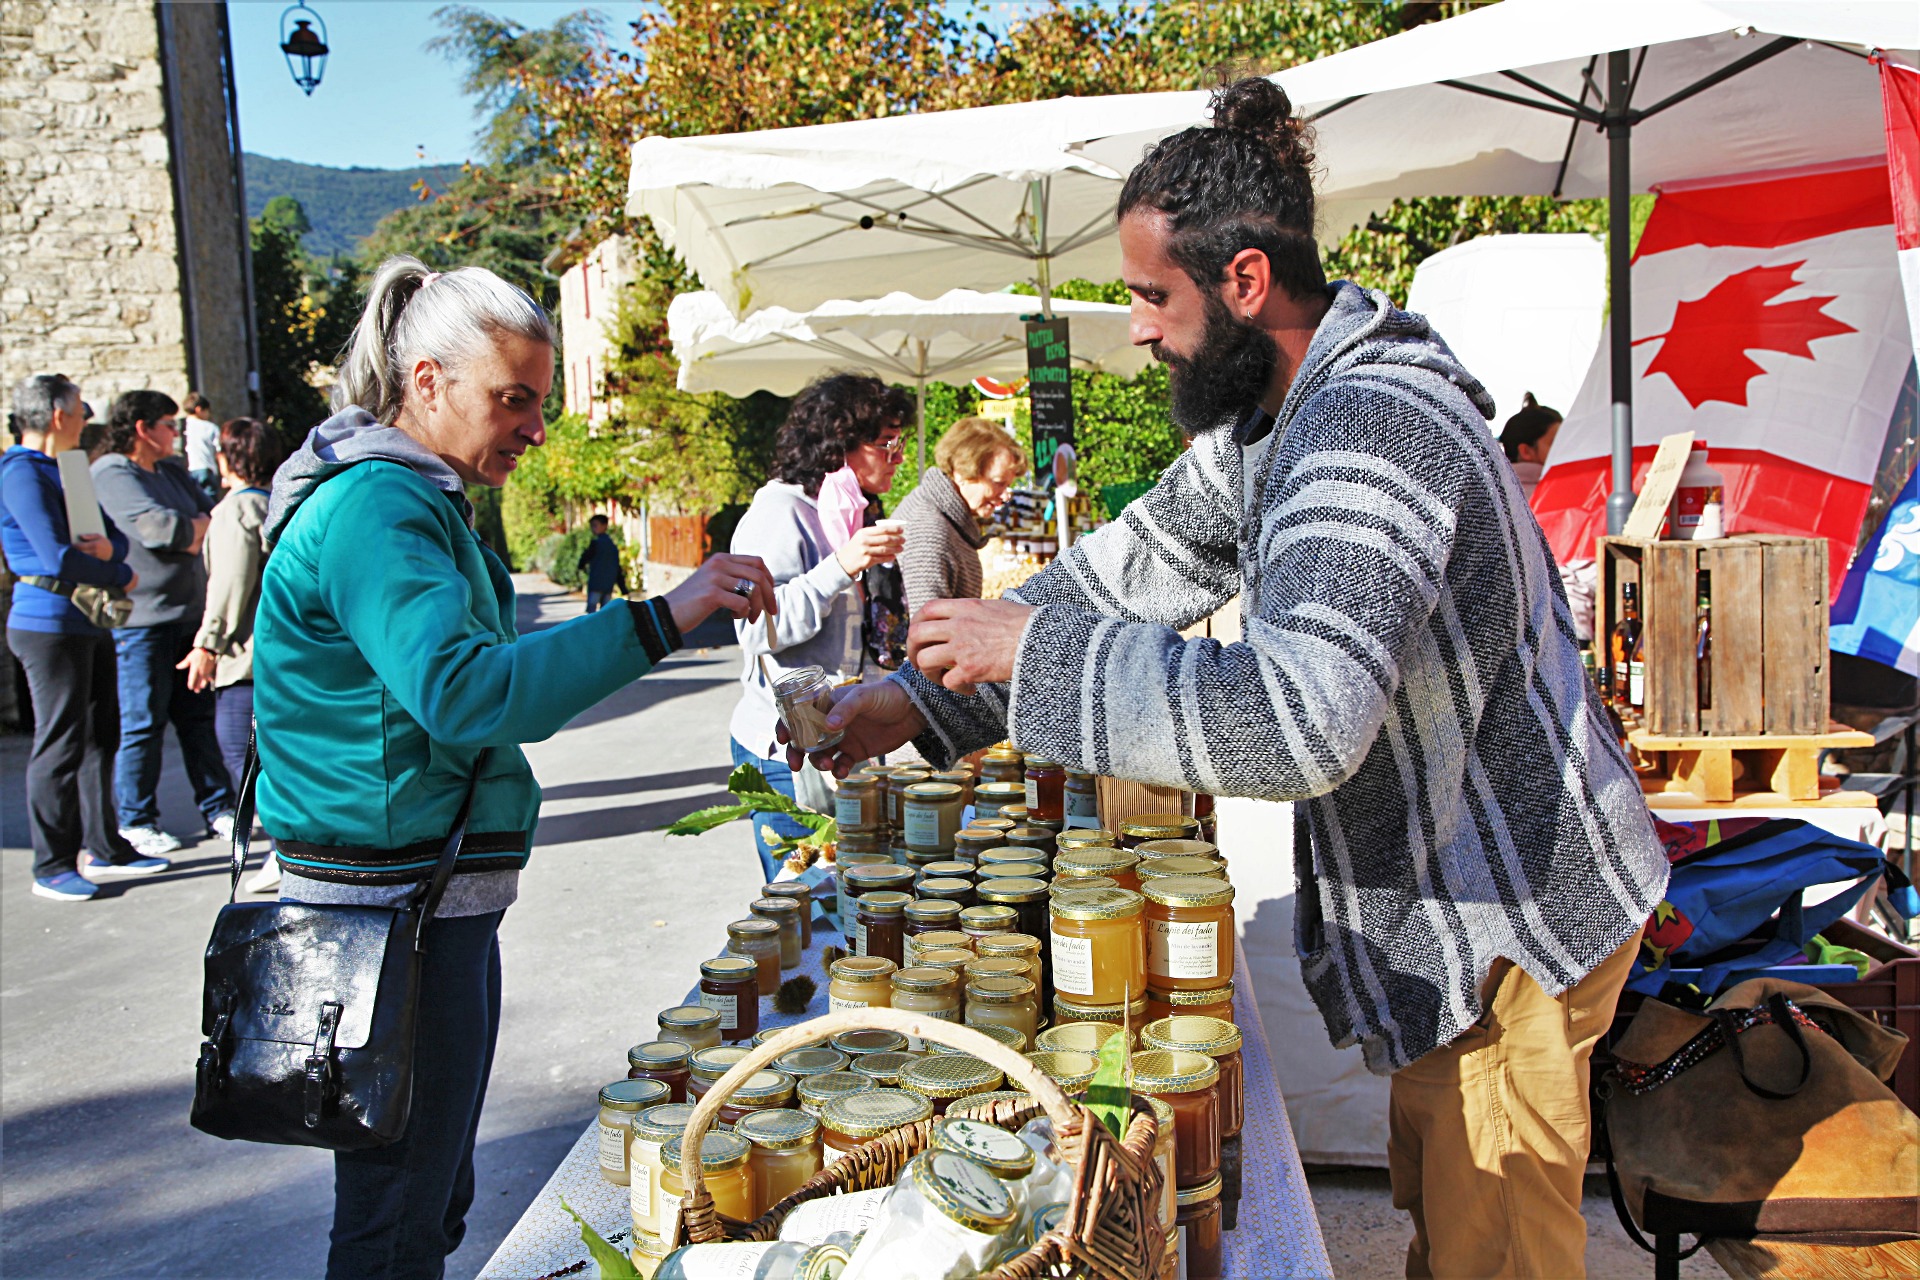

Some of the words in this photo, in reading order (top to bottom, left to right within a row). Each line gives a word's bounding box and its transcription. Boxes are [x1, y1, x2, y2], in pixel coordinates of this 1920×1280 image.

[1194, 923, 1213, 937] fado
[1068, 939, 1085, 951] fado
[609, 1129, 622, 1138] fado
